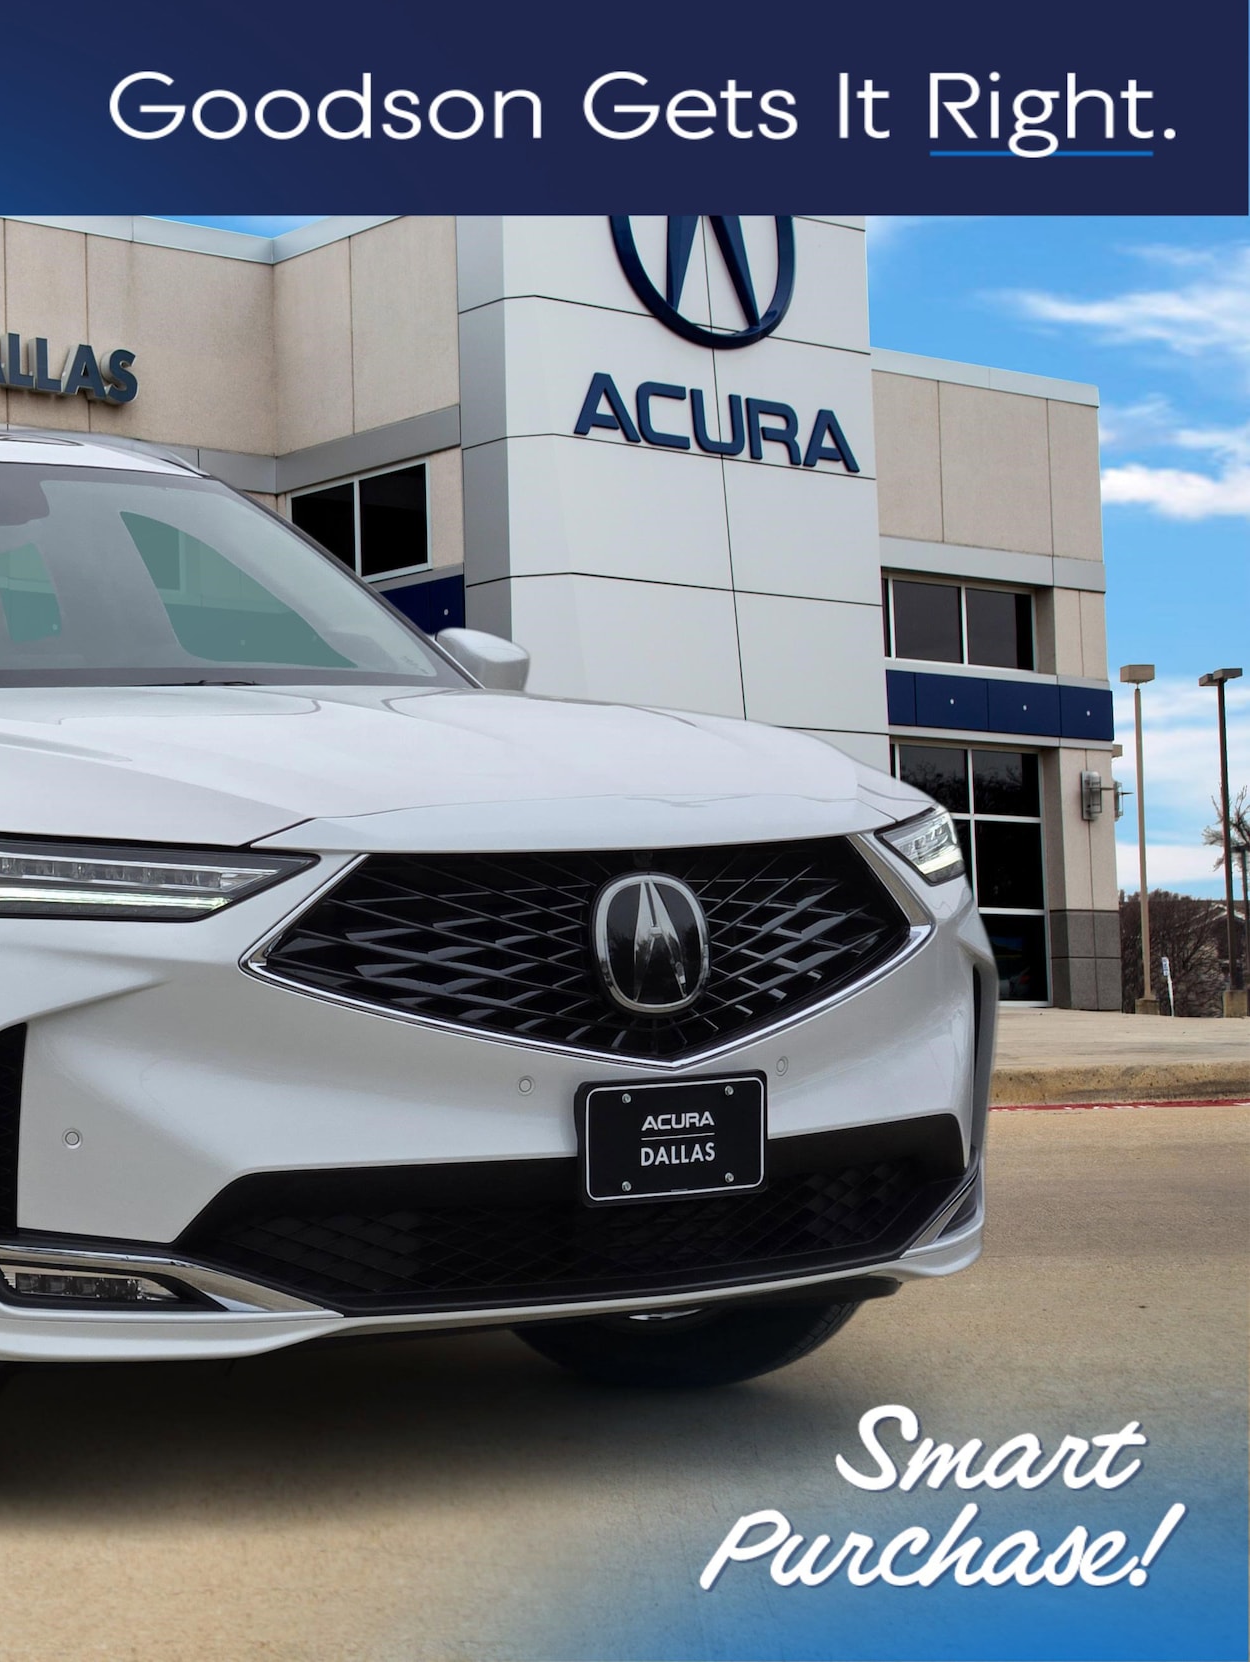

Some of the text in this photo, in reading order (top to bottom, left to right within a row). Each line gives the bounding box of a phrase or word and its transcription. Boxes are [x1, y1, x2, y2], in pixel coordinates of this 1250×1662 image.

[573, 372, 860, 473] ACURA
[641, 1111, 715, 1131] ACURA
[640, 1142, 716, 1167] DALLAS
